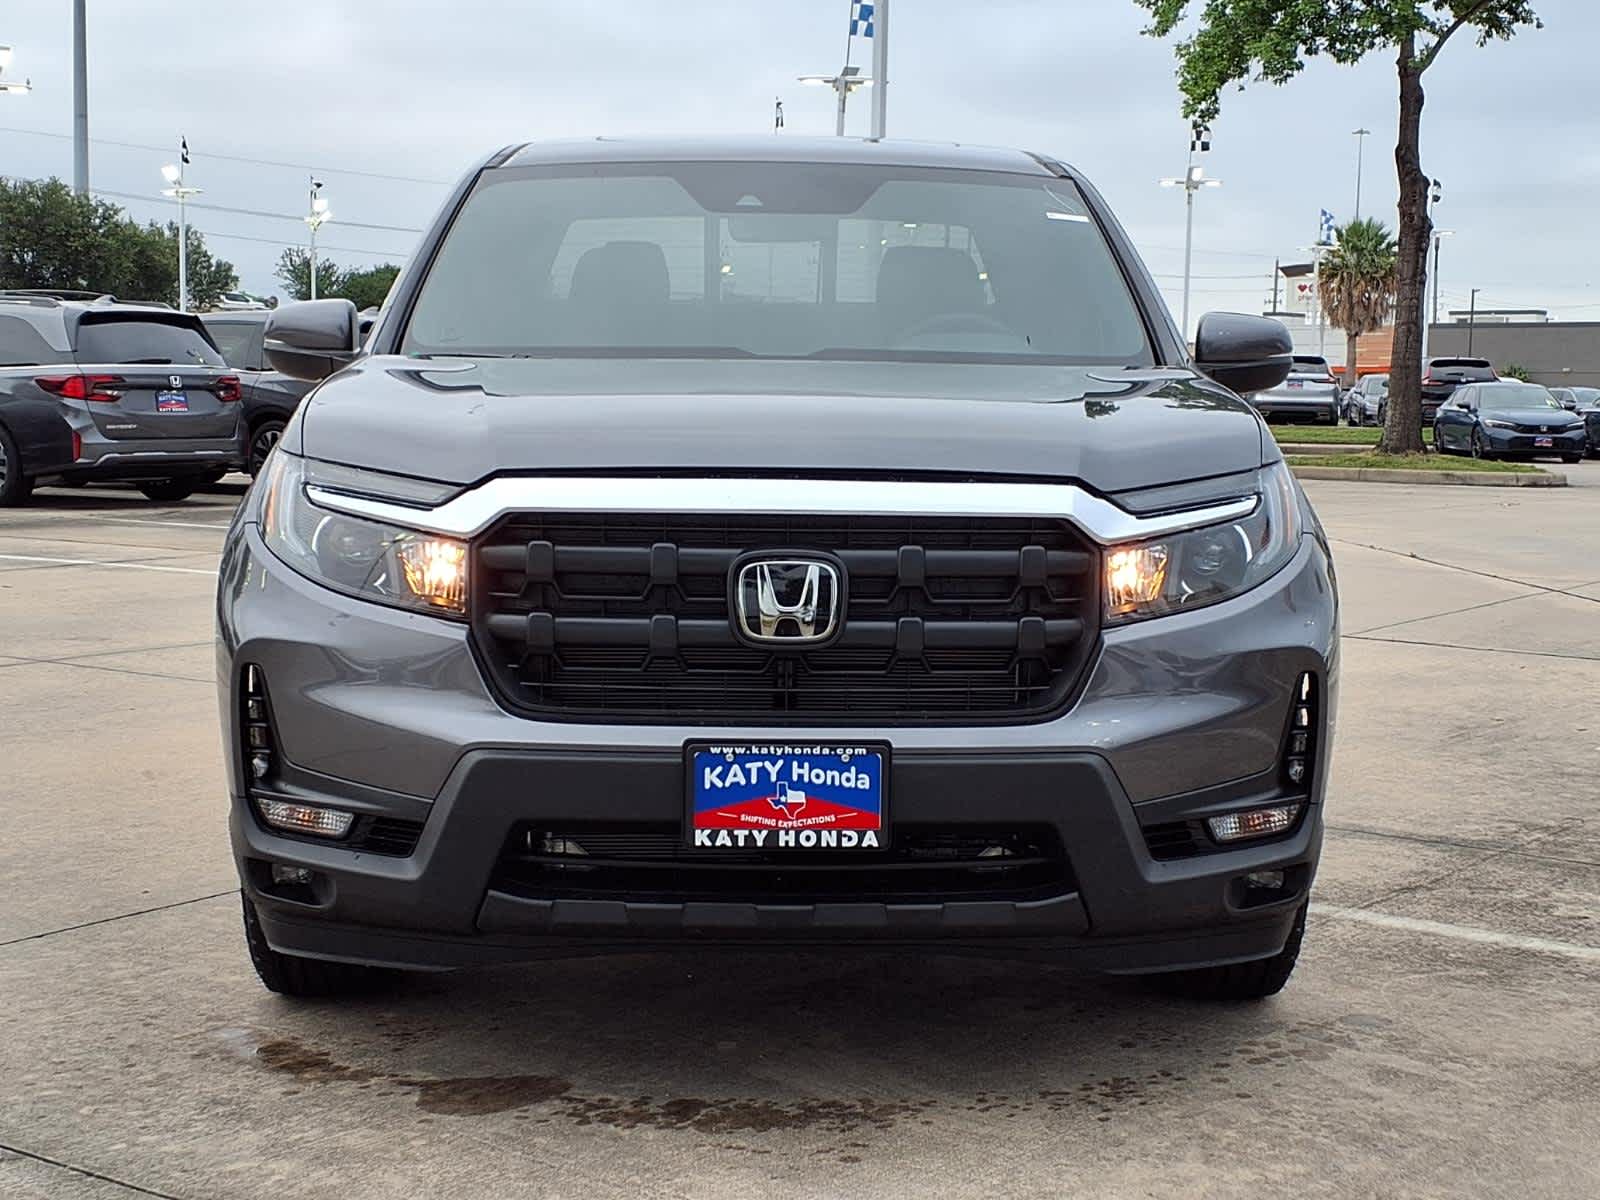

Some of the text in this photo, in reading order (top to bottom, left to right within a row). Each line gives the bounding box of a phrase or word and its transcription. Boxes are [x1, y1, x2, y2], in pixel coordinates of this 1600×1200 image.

[710, 746, 867, 755] www.katyhonda.com
[704, 759, 870, 789] KATY Honda
[740, 814, 836, 828] SHIFTING EXPECTATIONS
[694, 829, 880, 848] KATY HONDA
